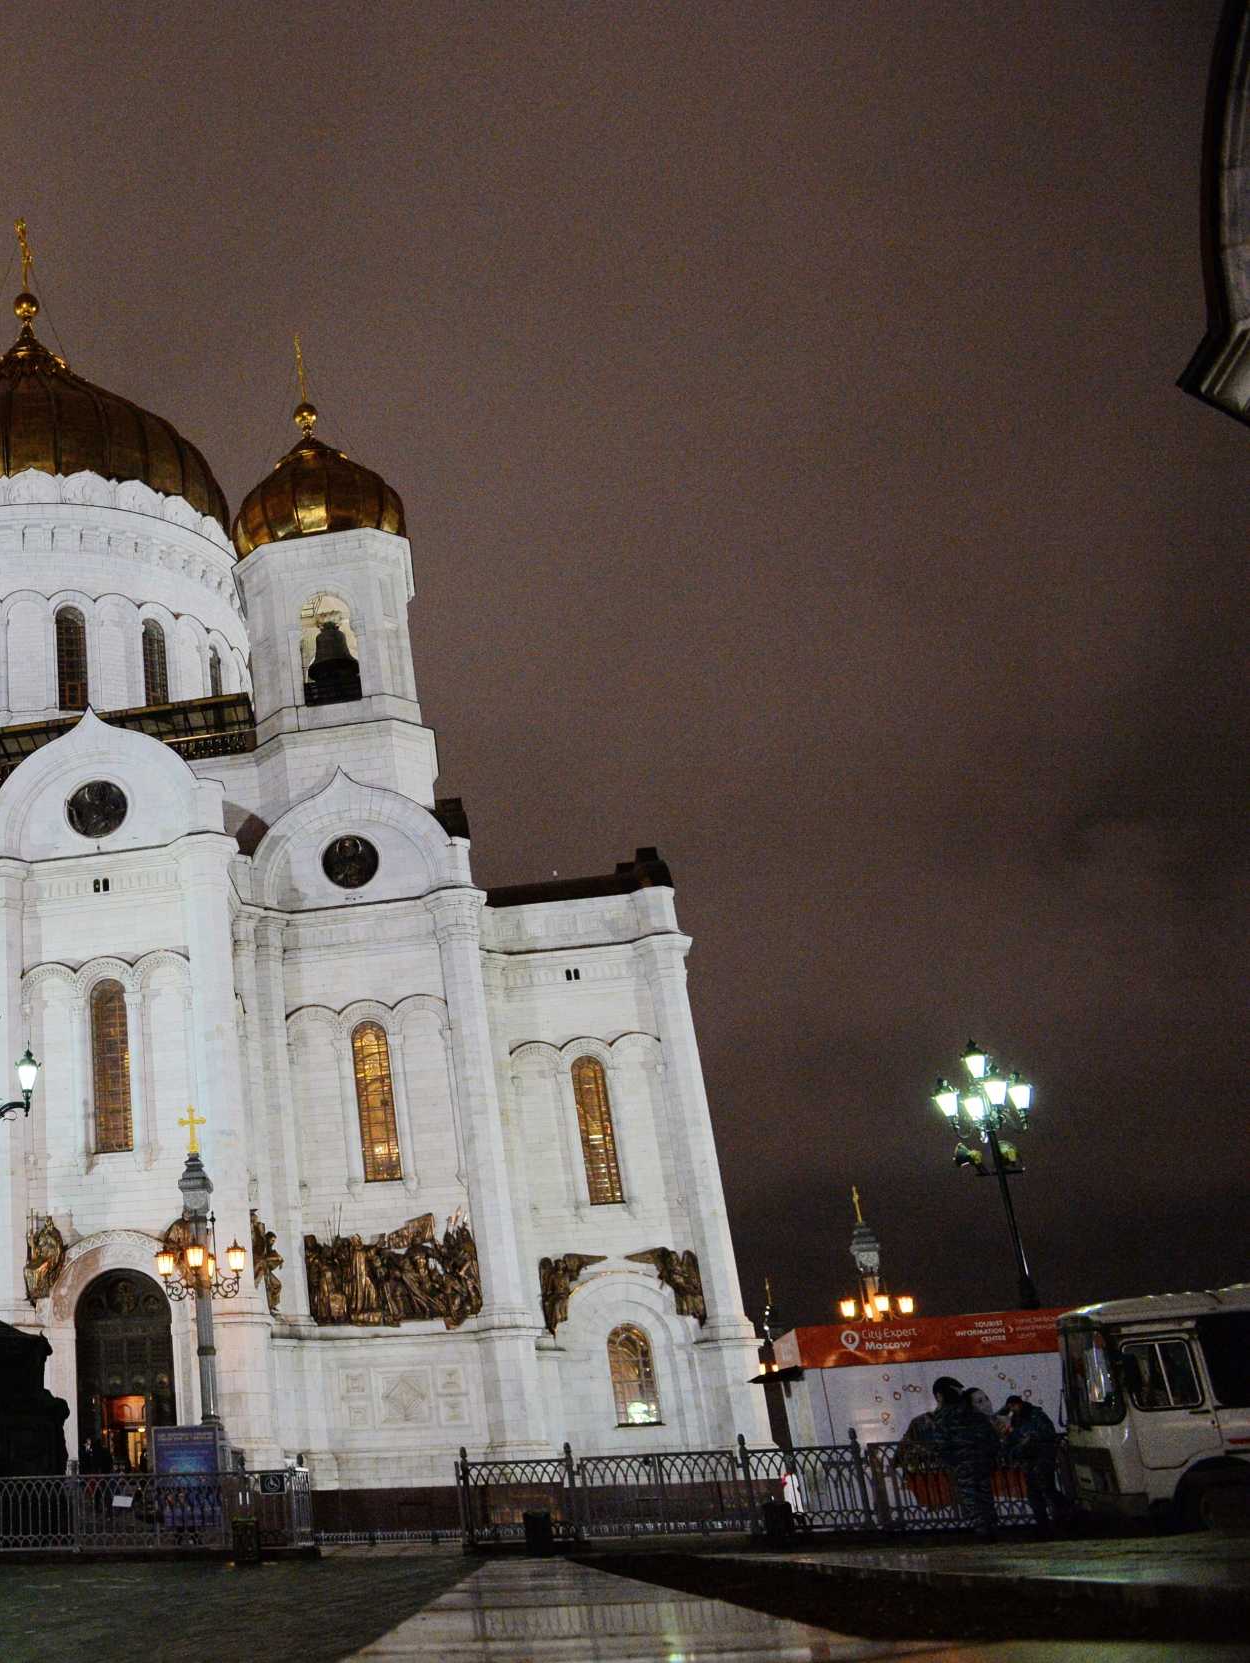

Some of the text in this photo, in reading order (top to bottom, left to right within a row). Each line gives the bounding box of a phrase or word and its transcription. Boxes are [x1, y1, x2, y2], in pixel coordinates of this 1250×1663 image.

[974, 1320, 1003, 1328] TOURIST
[861, 1327, 918, 1340] City Expert
[955, 1327, 1006, 1337] INFORMATION
[865, 1341, 911, 1351] Moscow
